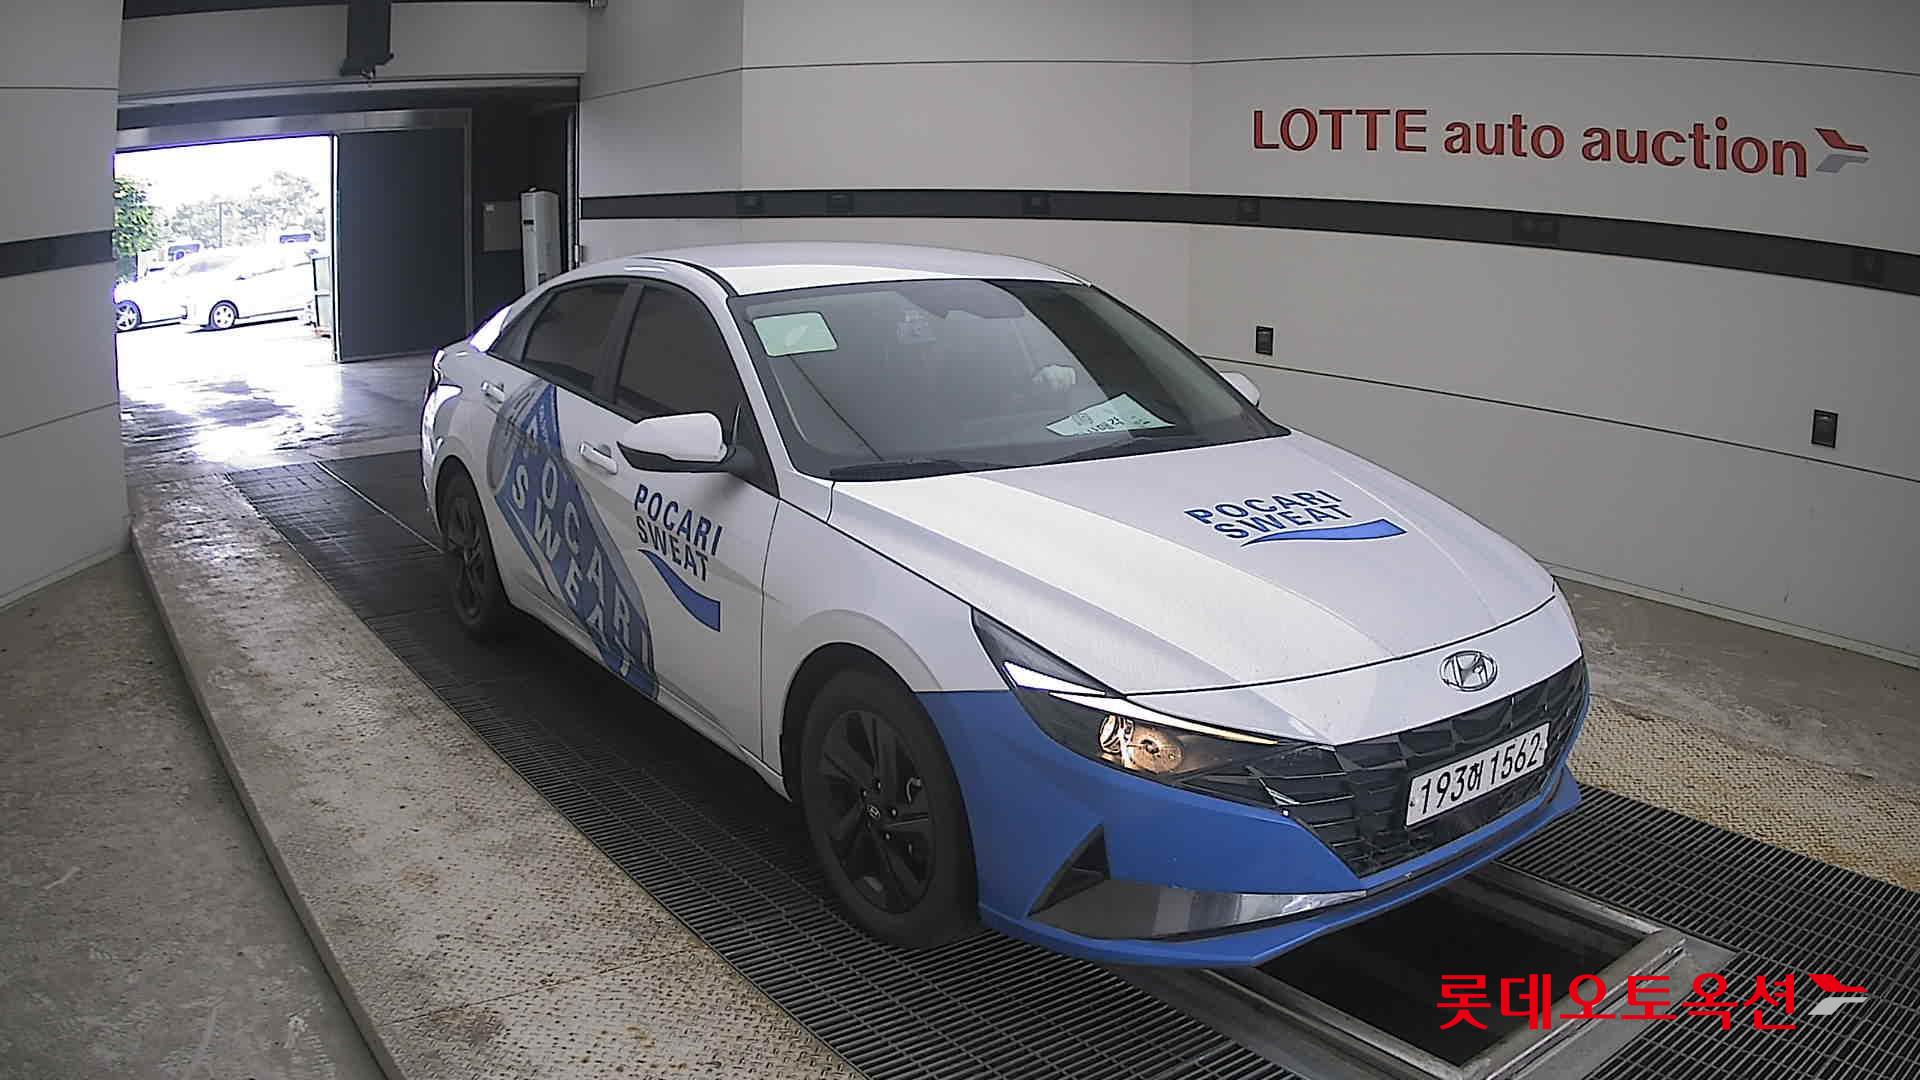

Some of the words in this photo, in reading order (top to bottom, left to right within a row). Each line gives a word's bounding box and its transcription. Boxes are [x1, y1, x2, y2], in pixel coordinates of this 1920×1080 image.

[1252, 108, 1428, 152] LOTTE
[1444, 113, 1566, 159] auto
[1581, 116, 1808, 178] auction
[633, 483, 724, 556] POCARI
[1184, 489, 1343, 525] POCARI
[1213, 503, 1353, 539] SWEAT
[636, 514, 711, 583] SWEAT
[1490, 732, 1542, 785] 1562
